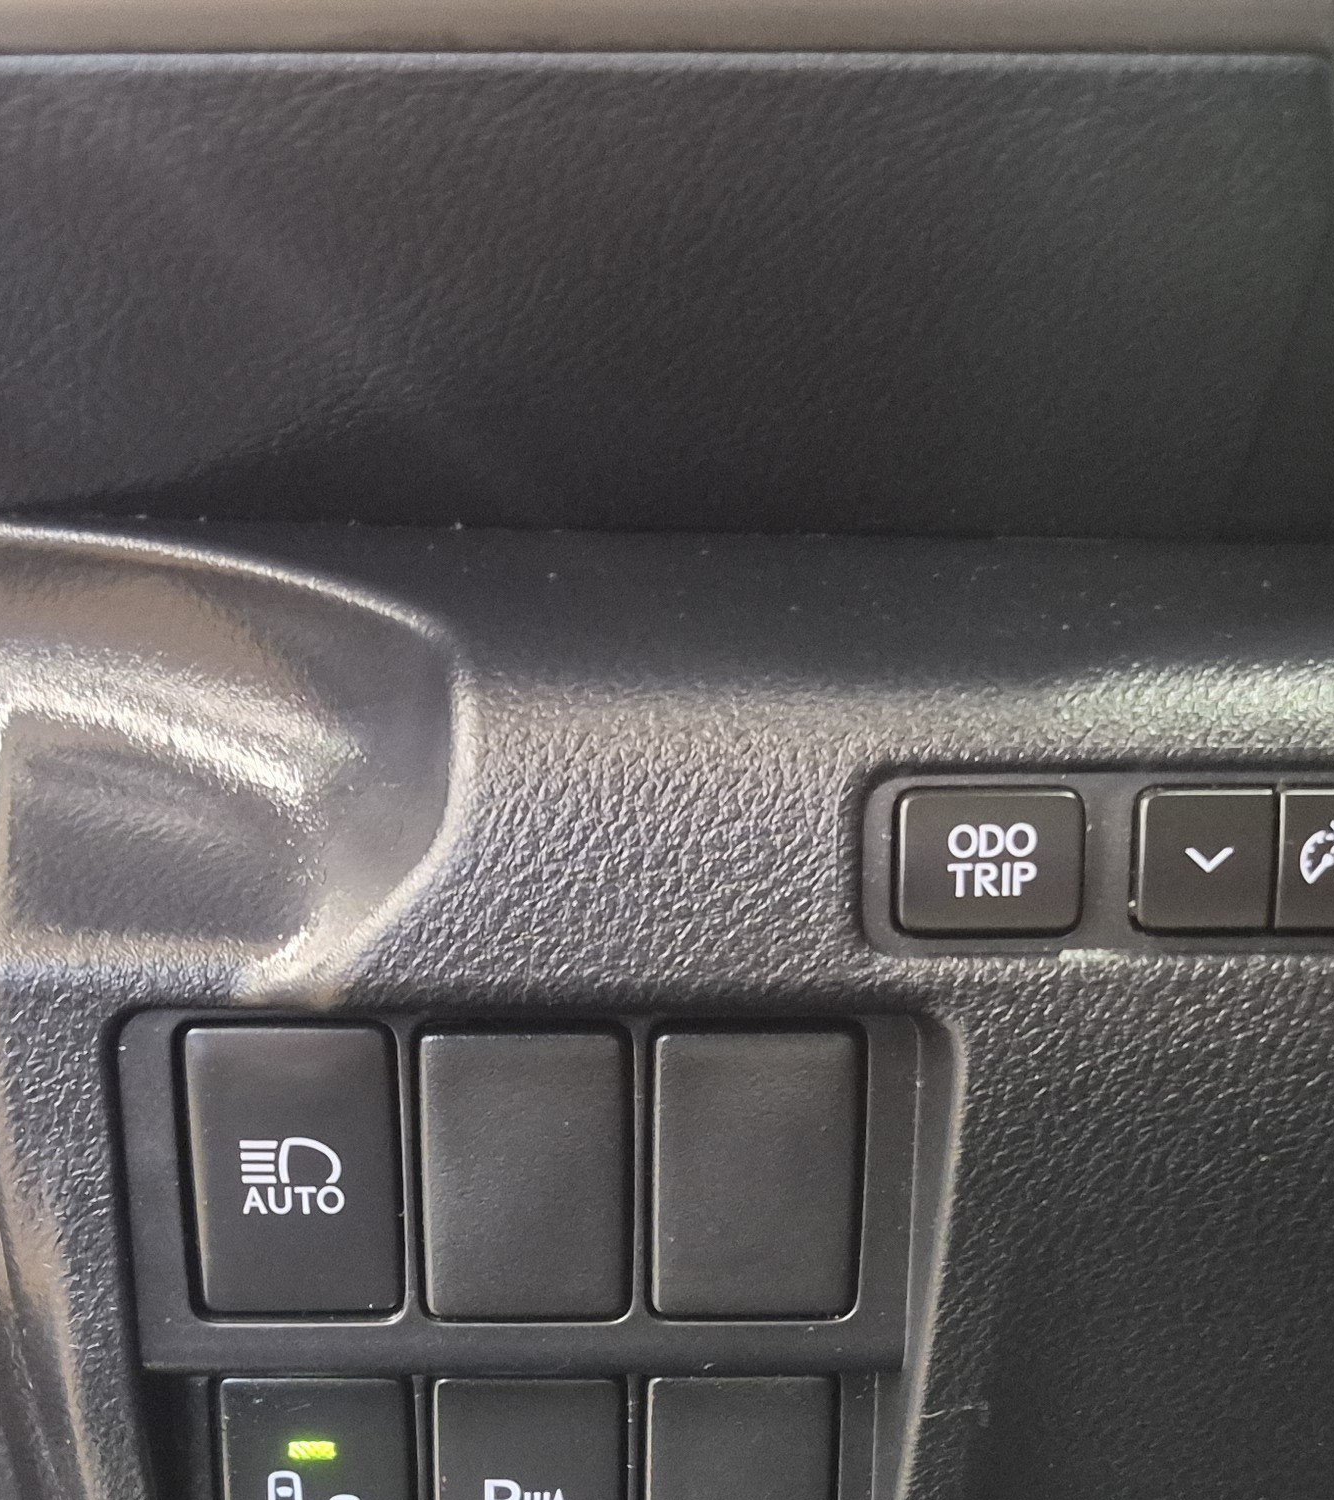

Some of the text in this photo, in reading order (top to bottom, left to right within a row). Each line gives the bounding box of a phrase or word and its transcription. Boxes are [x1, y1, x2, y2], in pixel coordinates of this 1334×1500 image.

[947, 822, 1038, 859] ODO
[947, 861, 1038, 898] TRIP
[242, 1185, 346, 1215] AUTO
